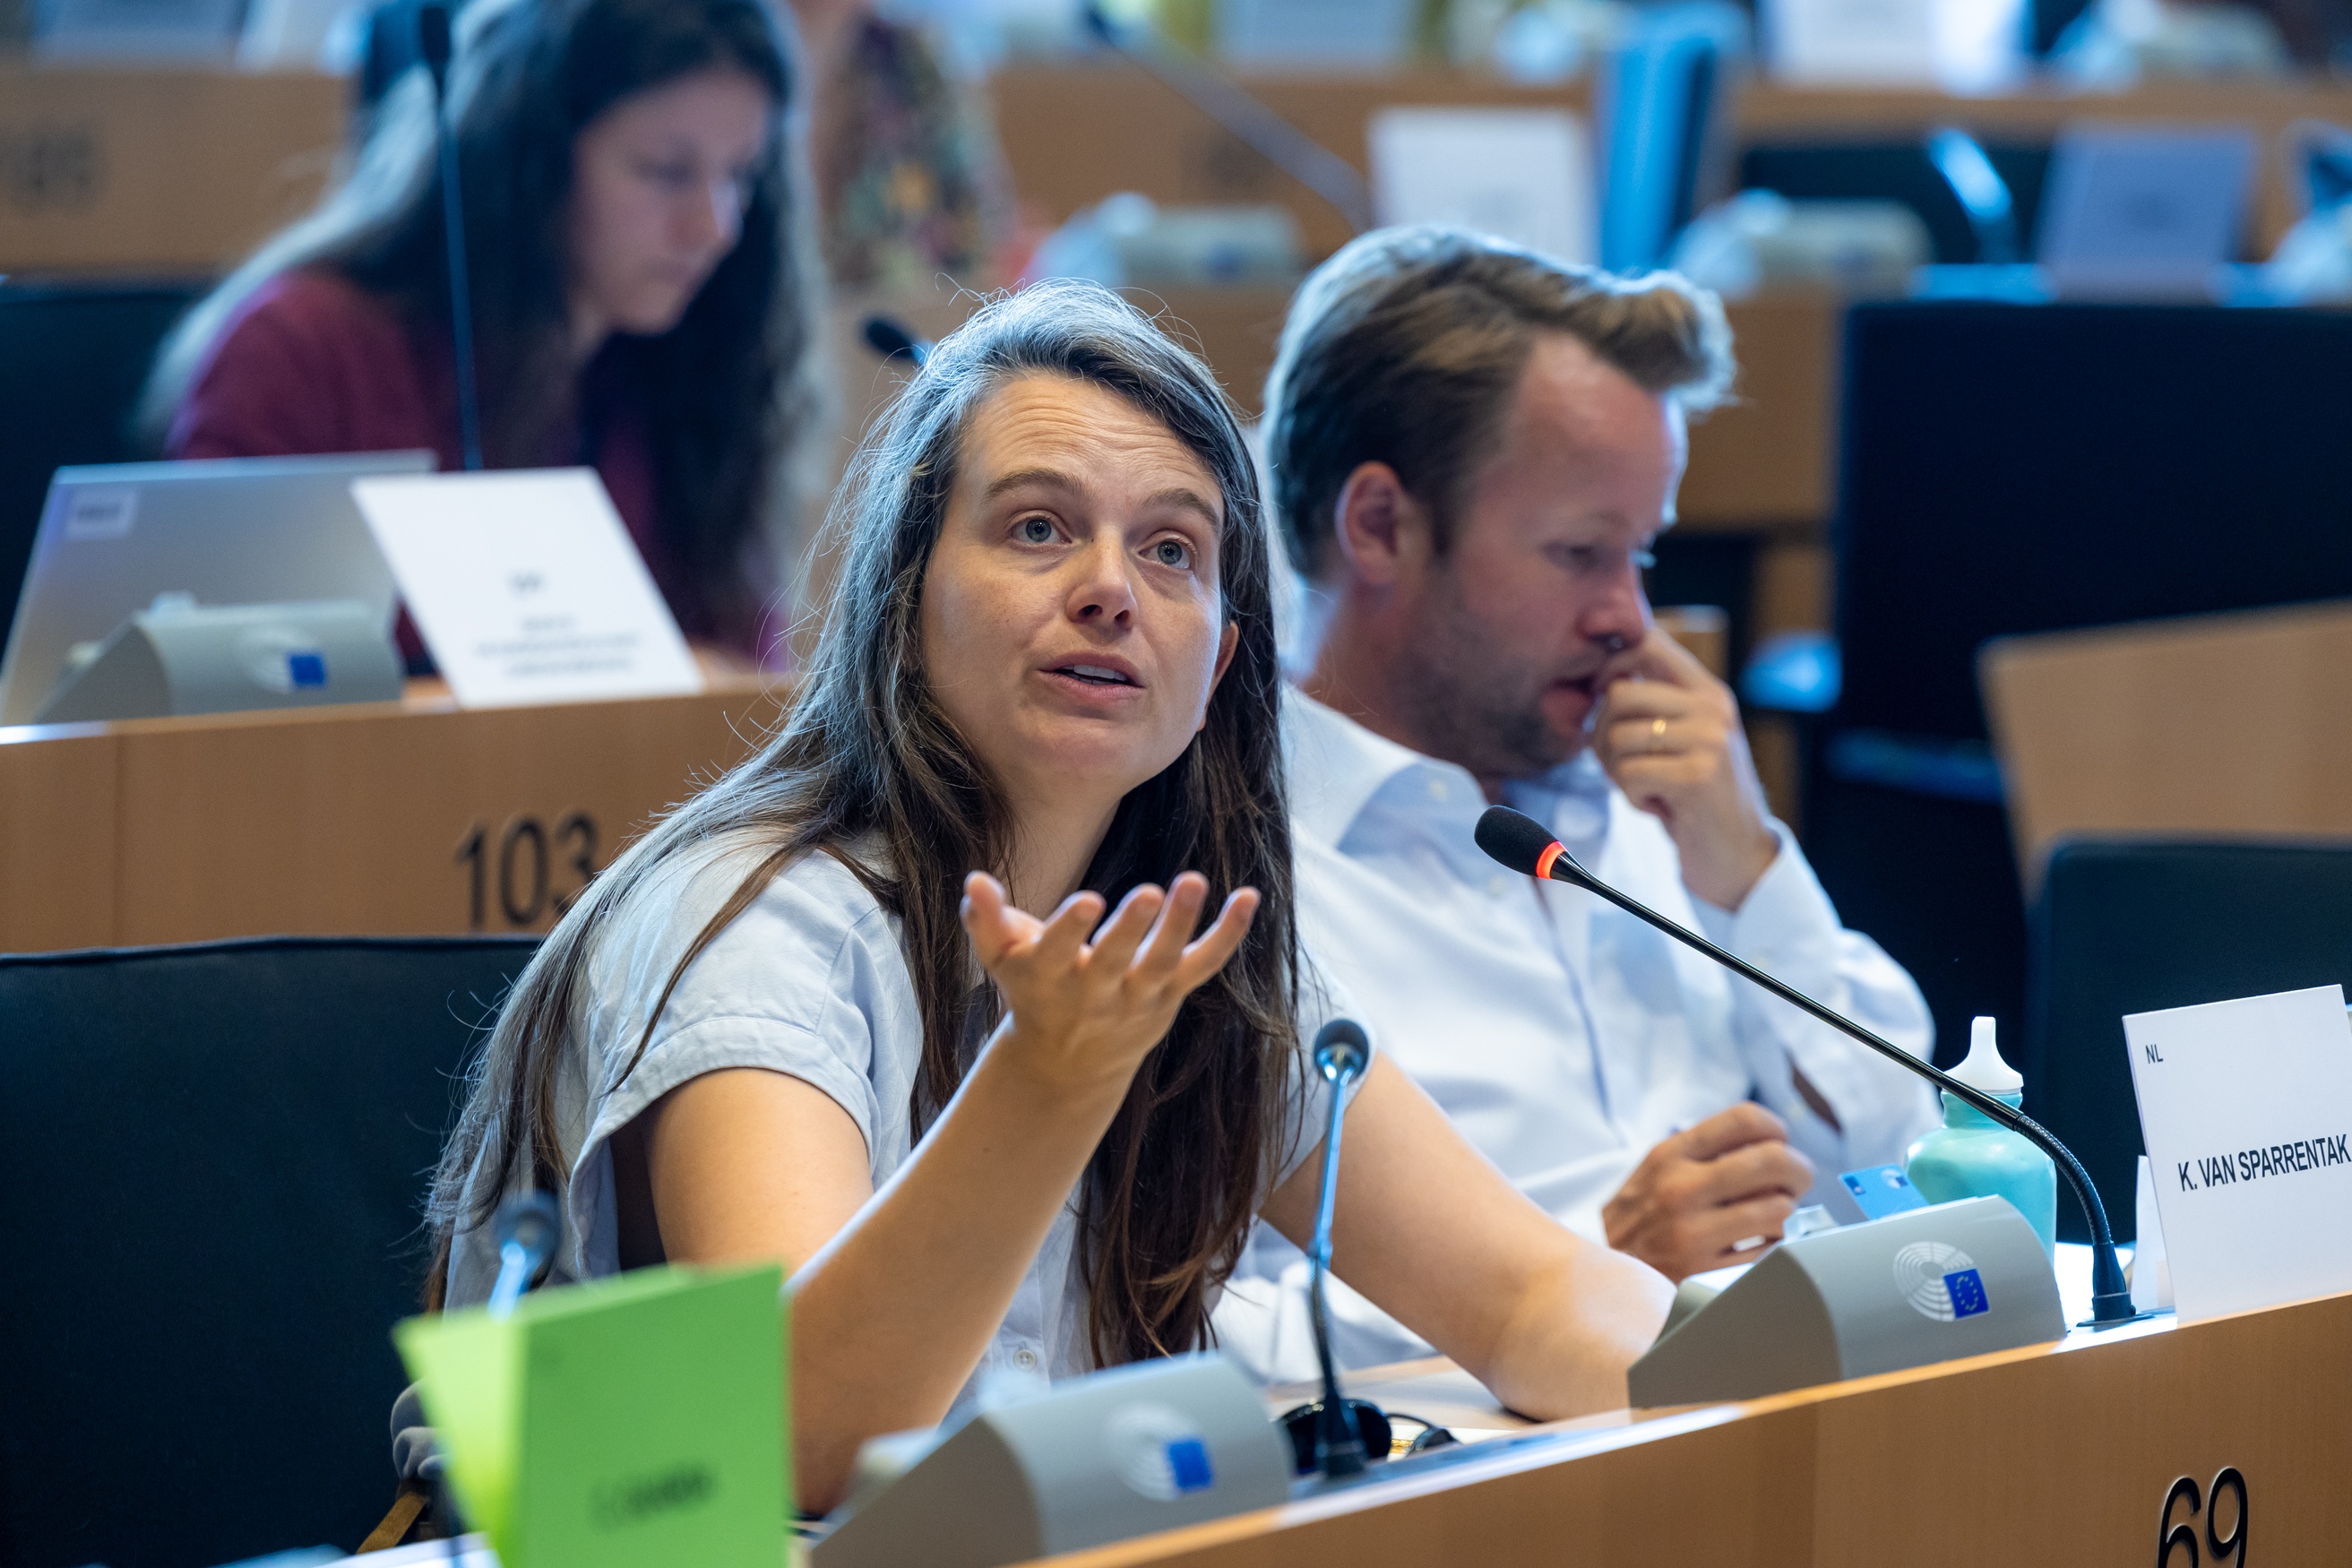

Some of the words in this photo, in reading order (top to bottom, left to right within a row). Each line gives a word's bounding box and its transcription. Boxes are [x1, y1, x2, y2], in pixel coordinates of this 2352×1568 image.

[453, 811, 599, 933] 103
[2145, 1043, 2164, 1064] NL
[2177, 1161, 2198, 1192] K.
[2198, 1154, 2236, 1188] VAN
[2238, 1133, 2352, 1181] SPARRENTAK
[2157, 1466, 2248, 1568] 69
